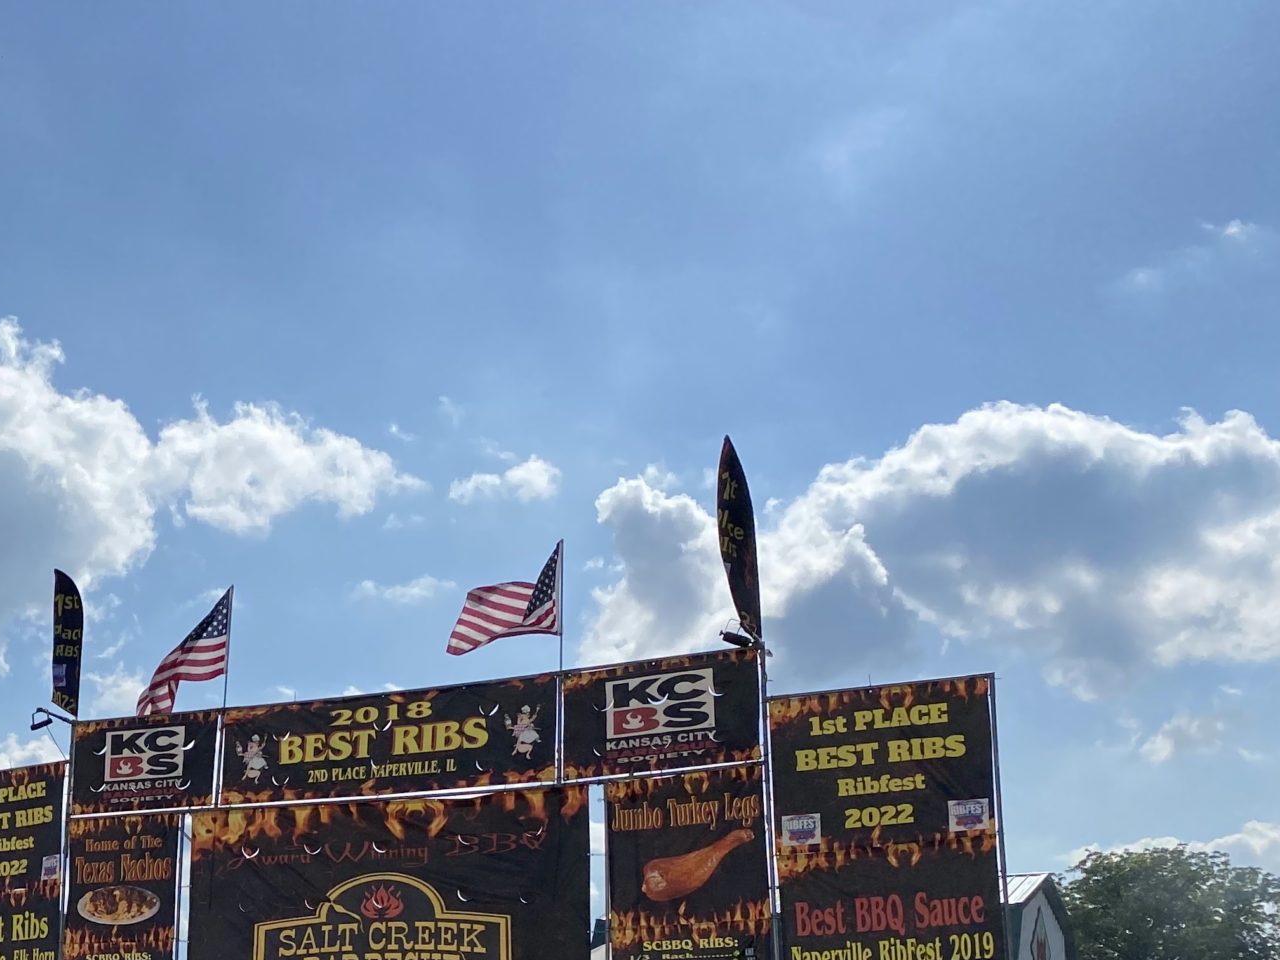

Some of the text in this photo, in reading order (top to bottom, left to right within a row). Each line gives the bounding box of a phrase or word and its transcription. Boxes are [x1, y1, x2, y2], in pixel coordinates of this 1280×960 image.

[613, 674, 706, 708] KC
[328, 700, 433, 727] 2018
[809, 702, 948, 736] 1st PLACE
[110, 730, 180, 755] KC
[277, 717, 490, 765] BEST RIBS
[606, 730, 717, 751] KANSAS CITY
[795, 734, 966, 772] BEST RIBS
[616, 750, 705, 764] SOCIETY
[307, 758, 457, 784] 2ND PLACE NAPERVILLE, IL
[103, 778, 182, 792] KANSAS CITY
[837, 773, 926, 797] Ribfest
[110, 794, 174, 804] SOCIETY
[612, 792, 760, 831] Jumbo Turkey Legs
[15, 805, 53, 828] RIBS
[844, 803, 915, 829] 2022
[85, 835, 162, 852] Home of The
[225, 830, 547, 871] Award Winning BBQ
[75, 851, 171, 884] Texas Nachos
[11, 911, 49, 942] Ribs
[794, 892, 985, 937] Best BBQ Sauce
[277, 921, 487, 957] SALT CREEK
[643, 937, 739, 951] SCBBQ RIBS:
[124, 952, 152, 960] RIBS:
